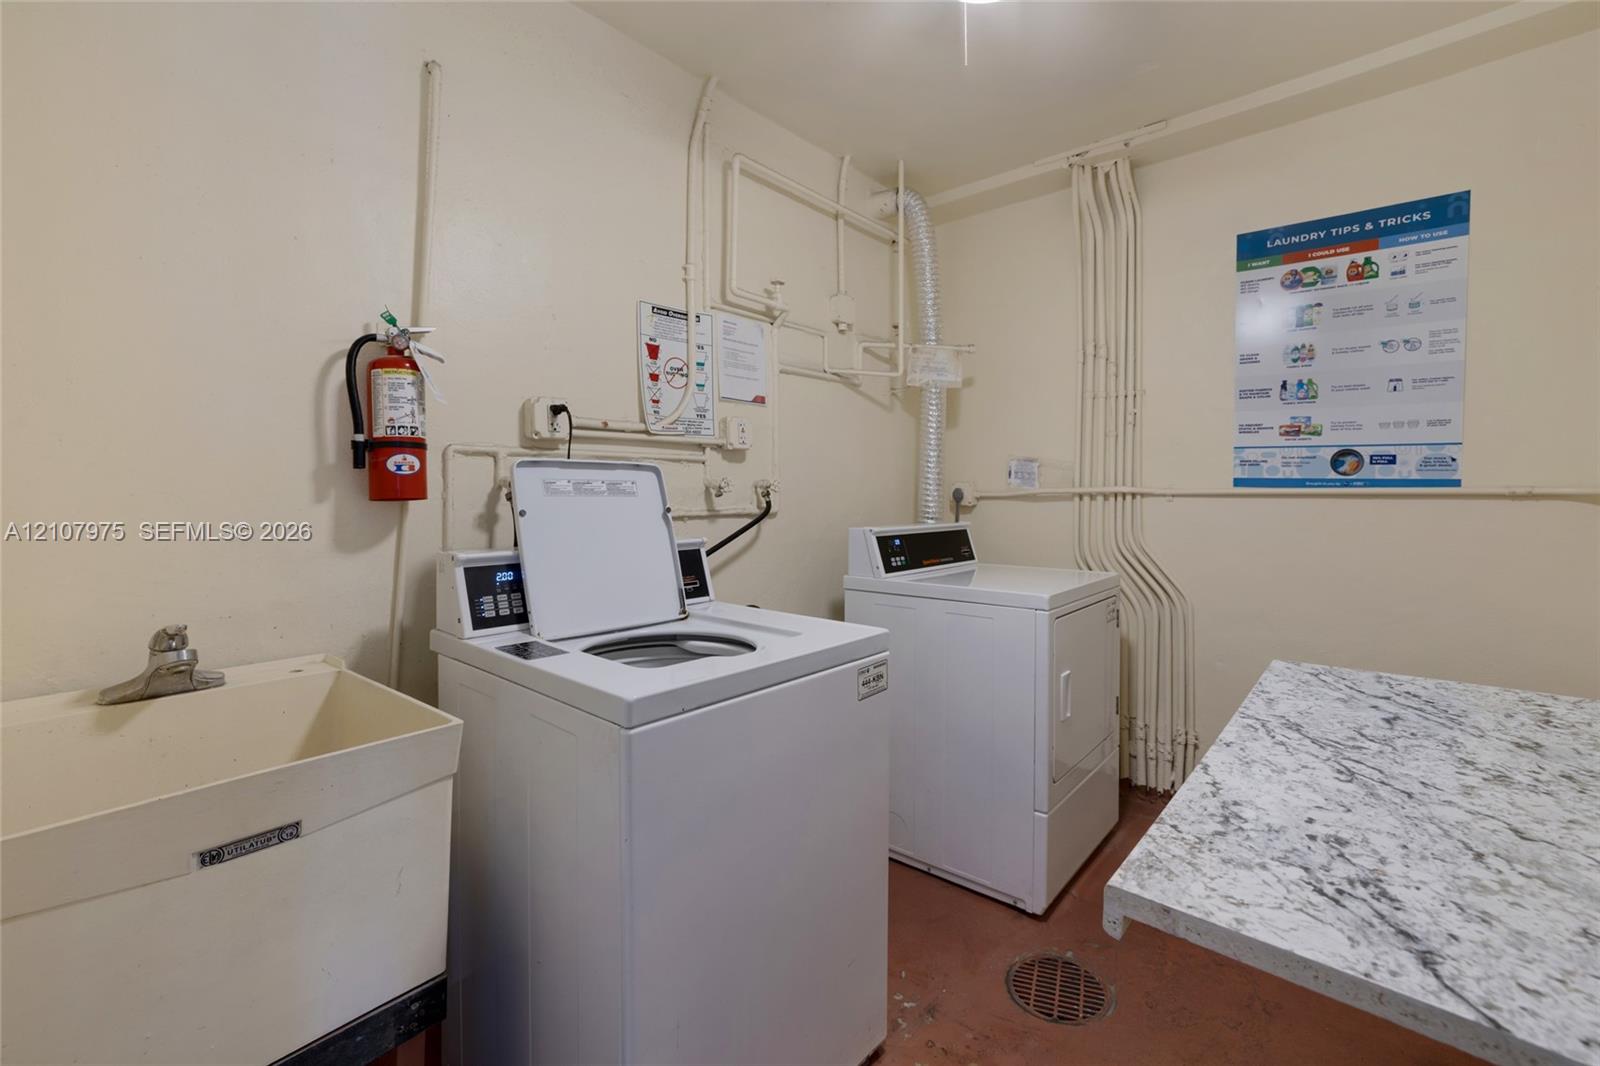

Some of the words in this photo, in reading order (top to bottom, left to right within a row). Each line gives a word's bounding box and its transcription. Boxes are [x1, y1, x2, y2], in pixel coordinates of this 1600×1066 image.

[1266, 230, 1326, 248] LAUNDRY
[1330, 222, 1361, 236] TIPS
[1364, 221, 1374, 231] &
[1378, 210, 1432, 228] TRICKS
[1398, 235, 1419, 243] HOW
[1420, 232, 1431, 240] TO
[1432, 230, 1449, 238] USE
[1312, 248, 1336, 258] COULD
[1336, 246, 1350, 255] USE
